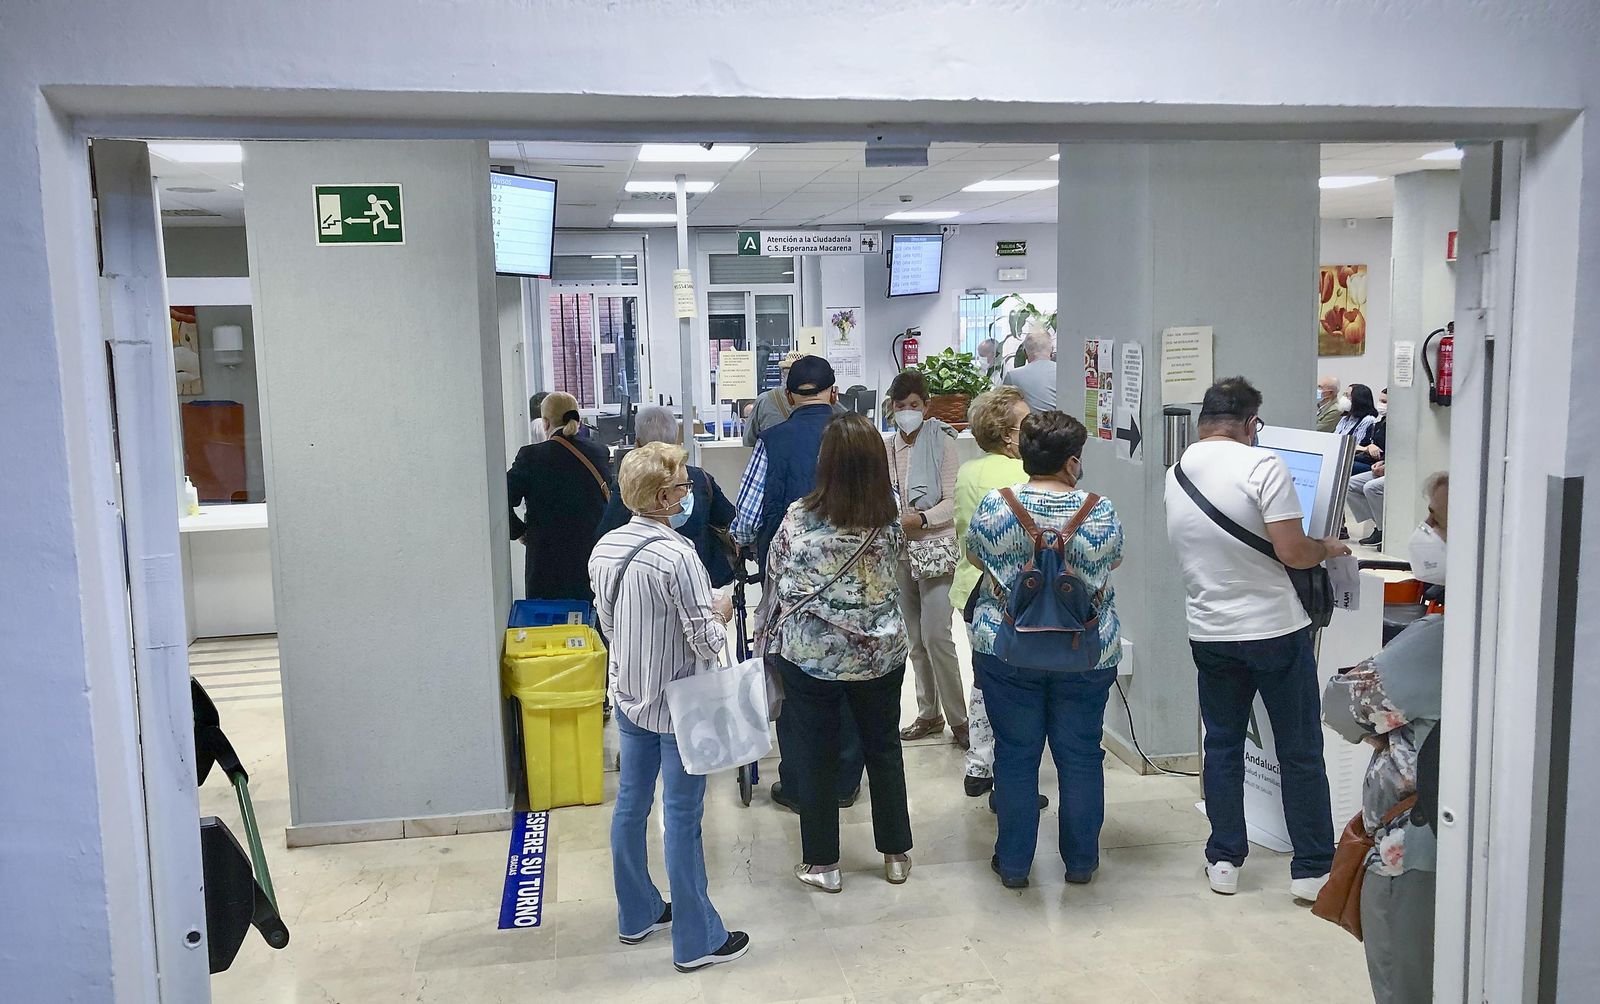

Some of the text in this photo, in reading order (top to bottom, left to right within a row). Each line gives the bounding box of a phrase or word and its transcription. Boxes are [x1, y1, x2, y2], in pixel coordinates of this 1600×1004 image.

[767, 235, 798, 243] Atención
[812, 235, 852, 243] Ciudadanía
[783, 245, 818, 253] Esperanza
[810, 335, 817, 345] 1
[1245, 751, 1281, 775] Andalucí
[509, 855, 519, 876] GRACIAS
[514, 812, 546, 927] ESPERE SU TURNO
